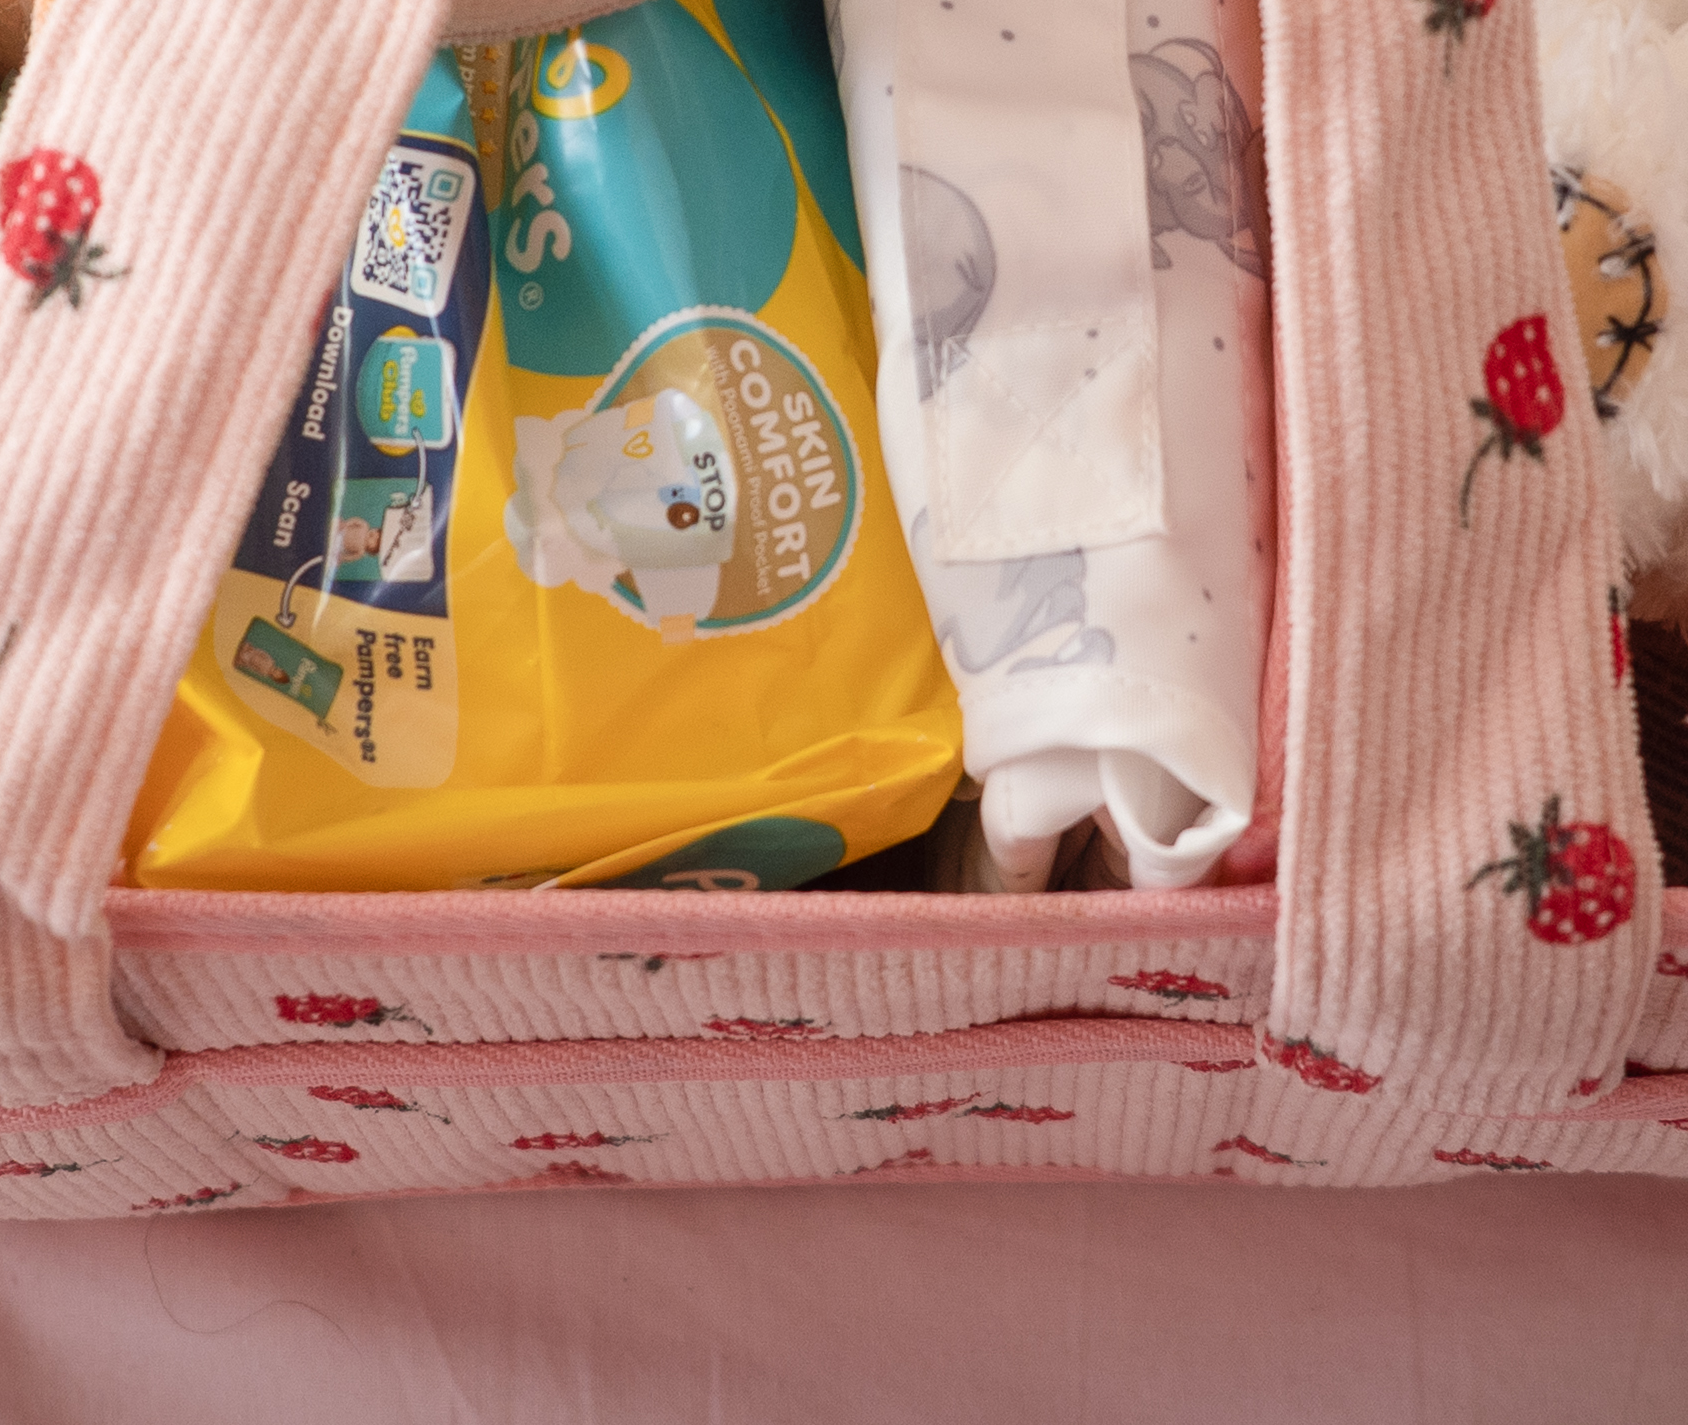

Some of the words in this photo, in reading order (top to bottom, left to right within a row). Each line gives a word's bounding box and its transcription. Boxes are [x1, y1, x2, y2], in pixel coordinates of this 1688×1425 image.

[301, 306, 354, 442] Download
[692, 450, 728, 533] STOP
[729, 339, 811, 581] COMFORT
[782, 391, 842, 509] SKIN
[273, 480, 311, 548] Scan
[384, 631, 406, 680] free
[413, 636, 435, 691] Earn
